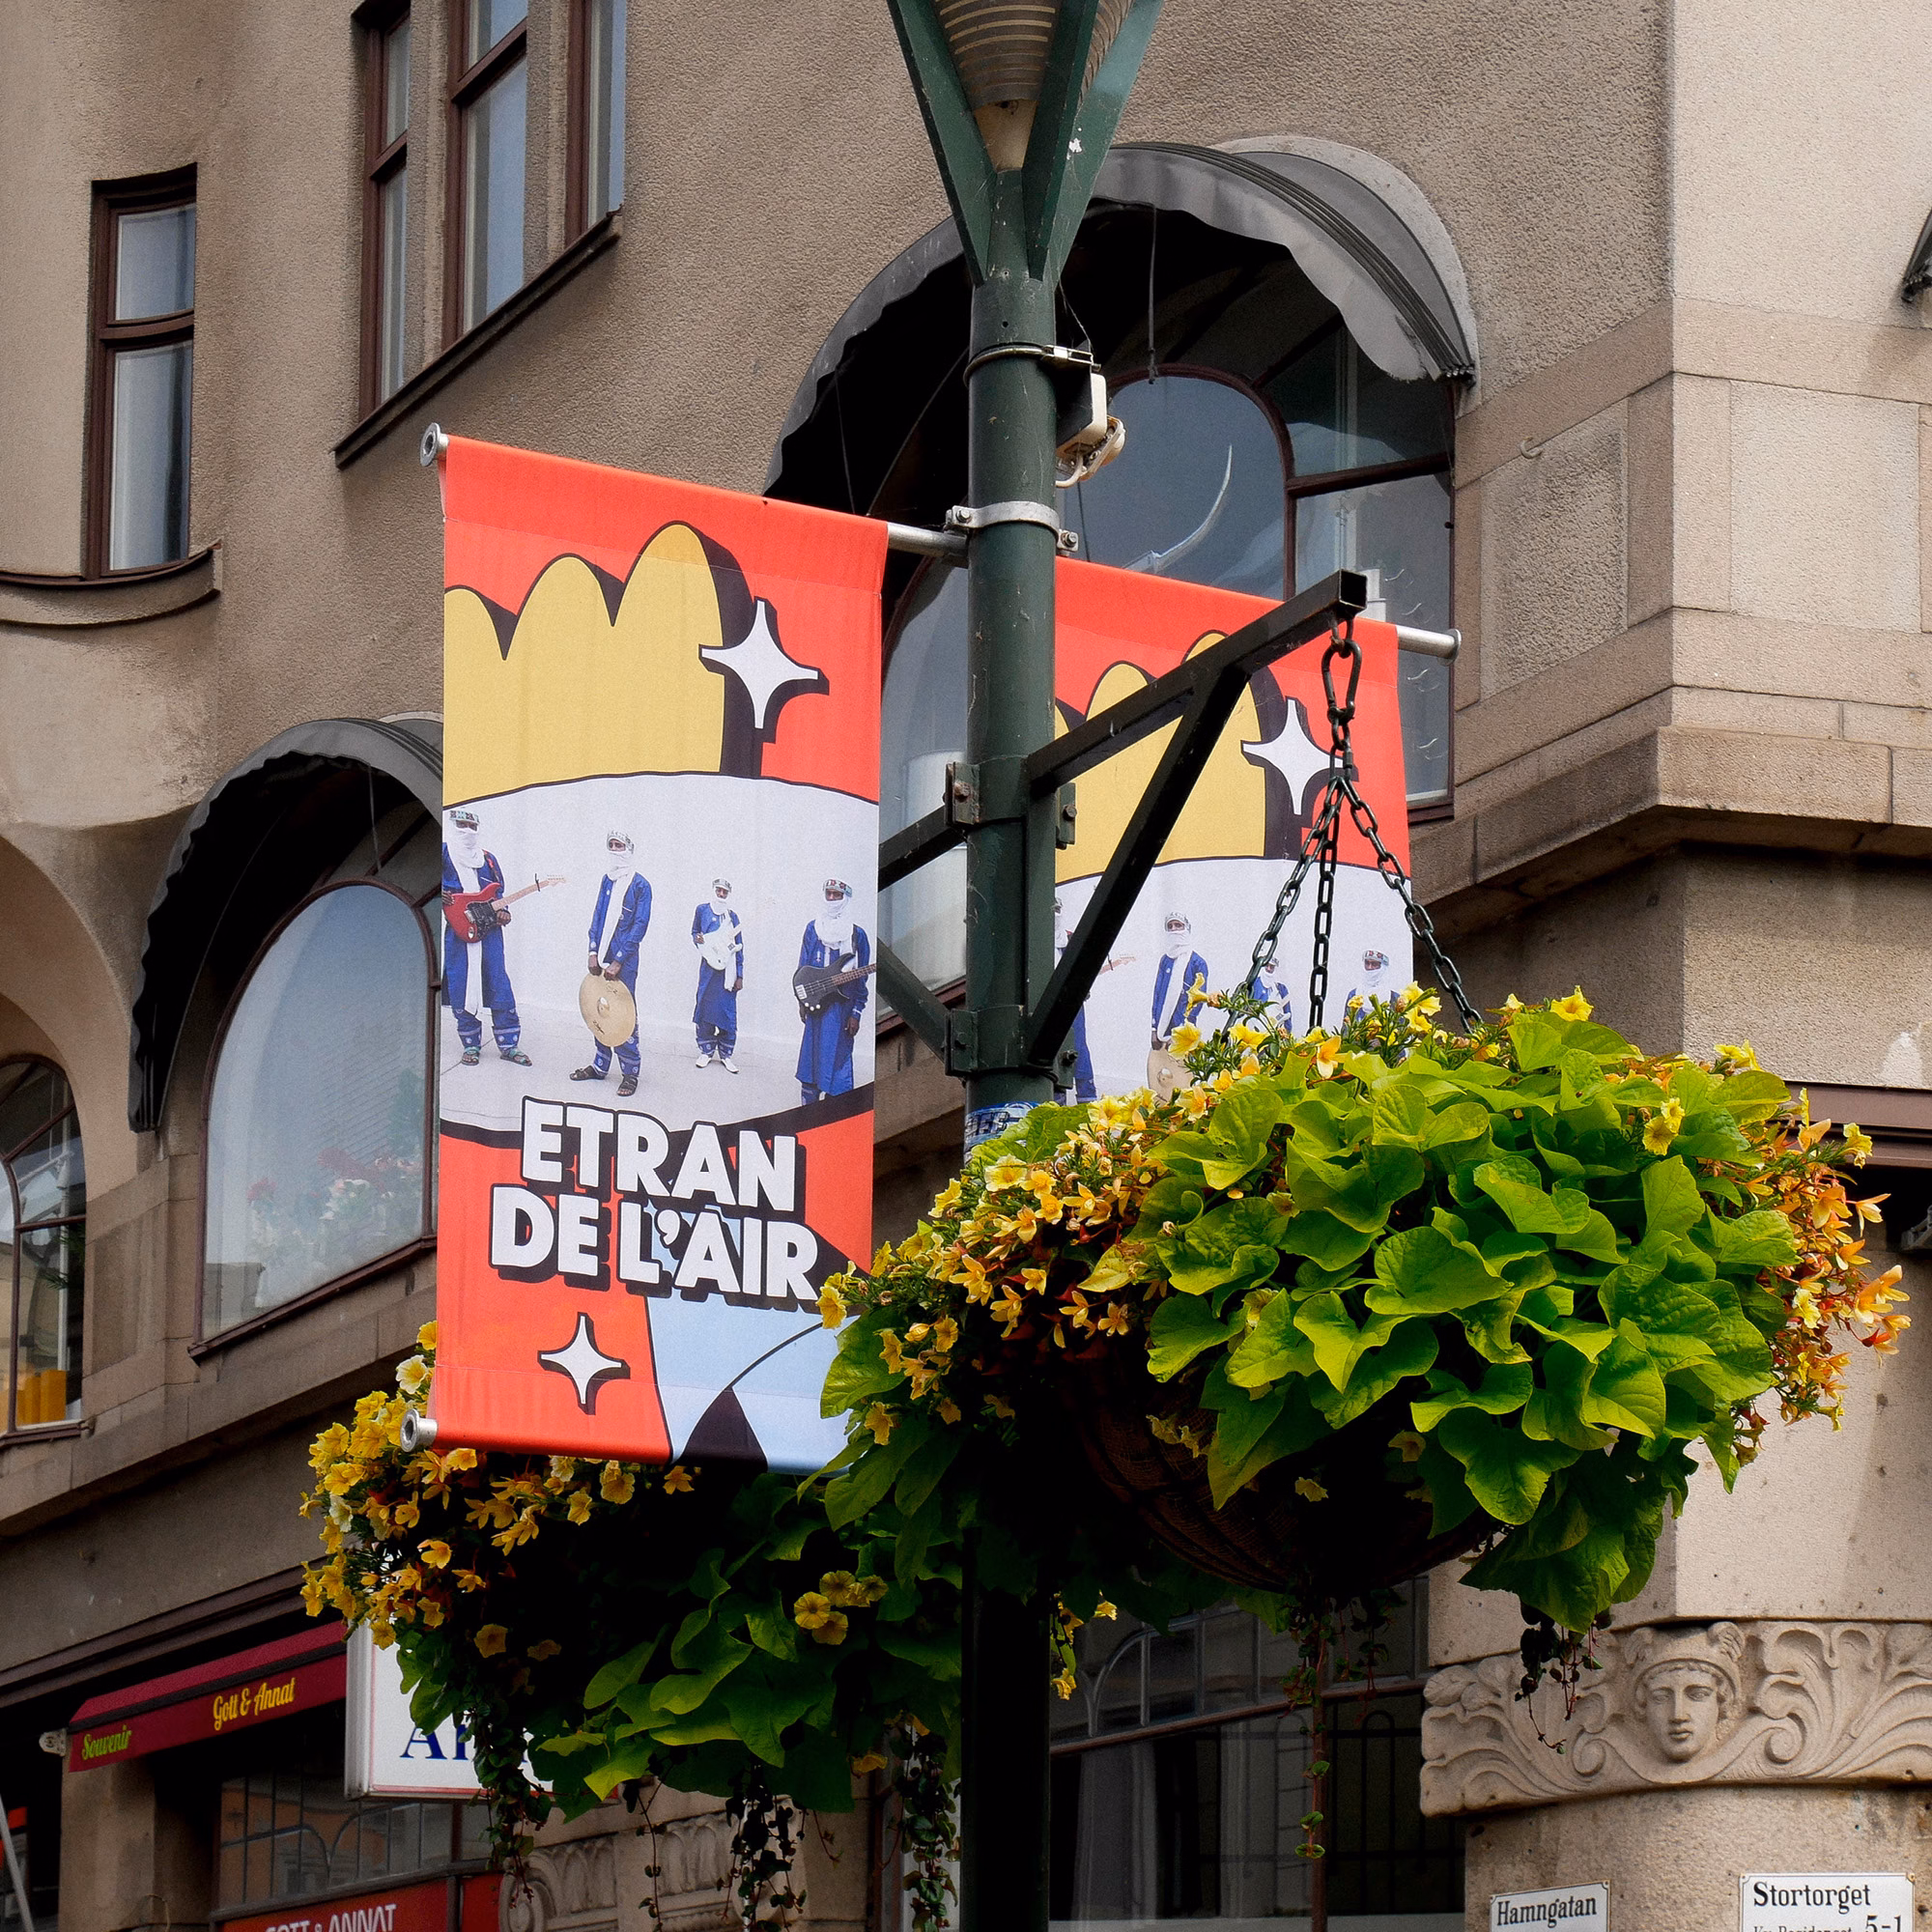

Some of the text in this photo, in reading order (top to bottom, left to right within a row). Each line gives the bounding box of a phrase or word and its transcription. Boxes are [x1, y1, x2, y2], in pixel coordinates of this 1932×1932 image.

[522, 1096, 796, 1212] ETRAN
[491, 1185, 820, 1301] DE L’AIR
[213, 1677, 296, 1731] Gott & Annat
[82, 1724, 132, 1760] Souvenir
[1496, 1895, 1597, 1929] Hamngatan
[1753, 1882, 1871, 1915] Stortorget
